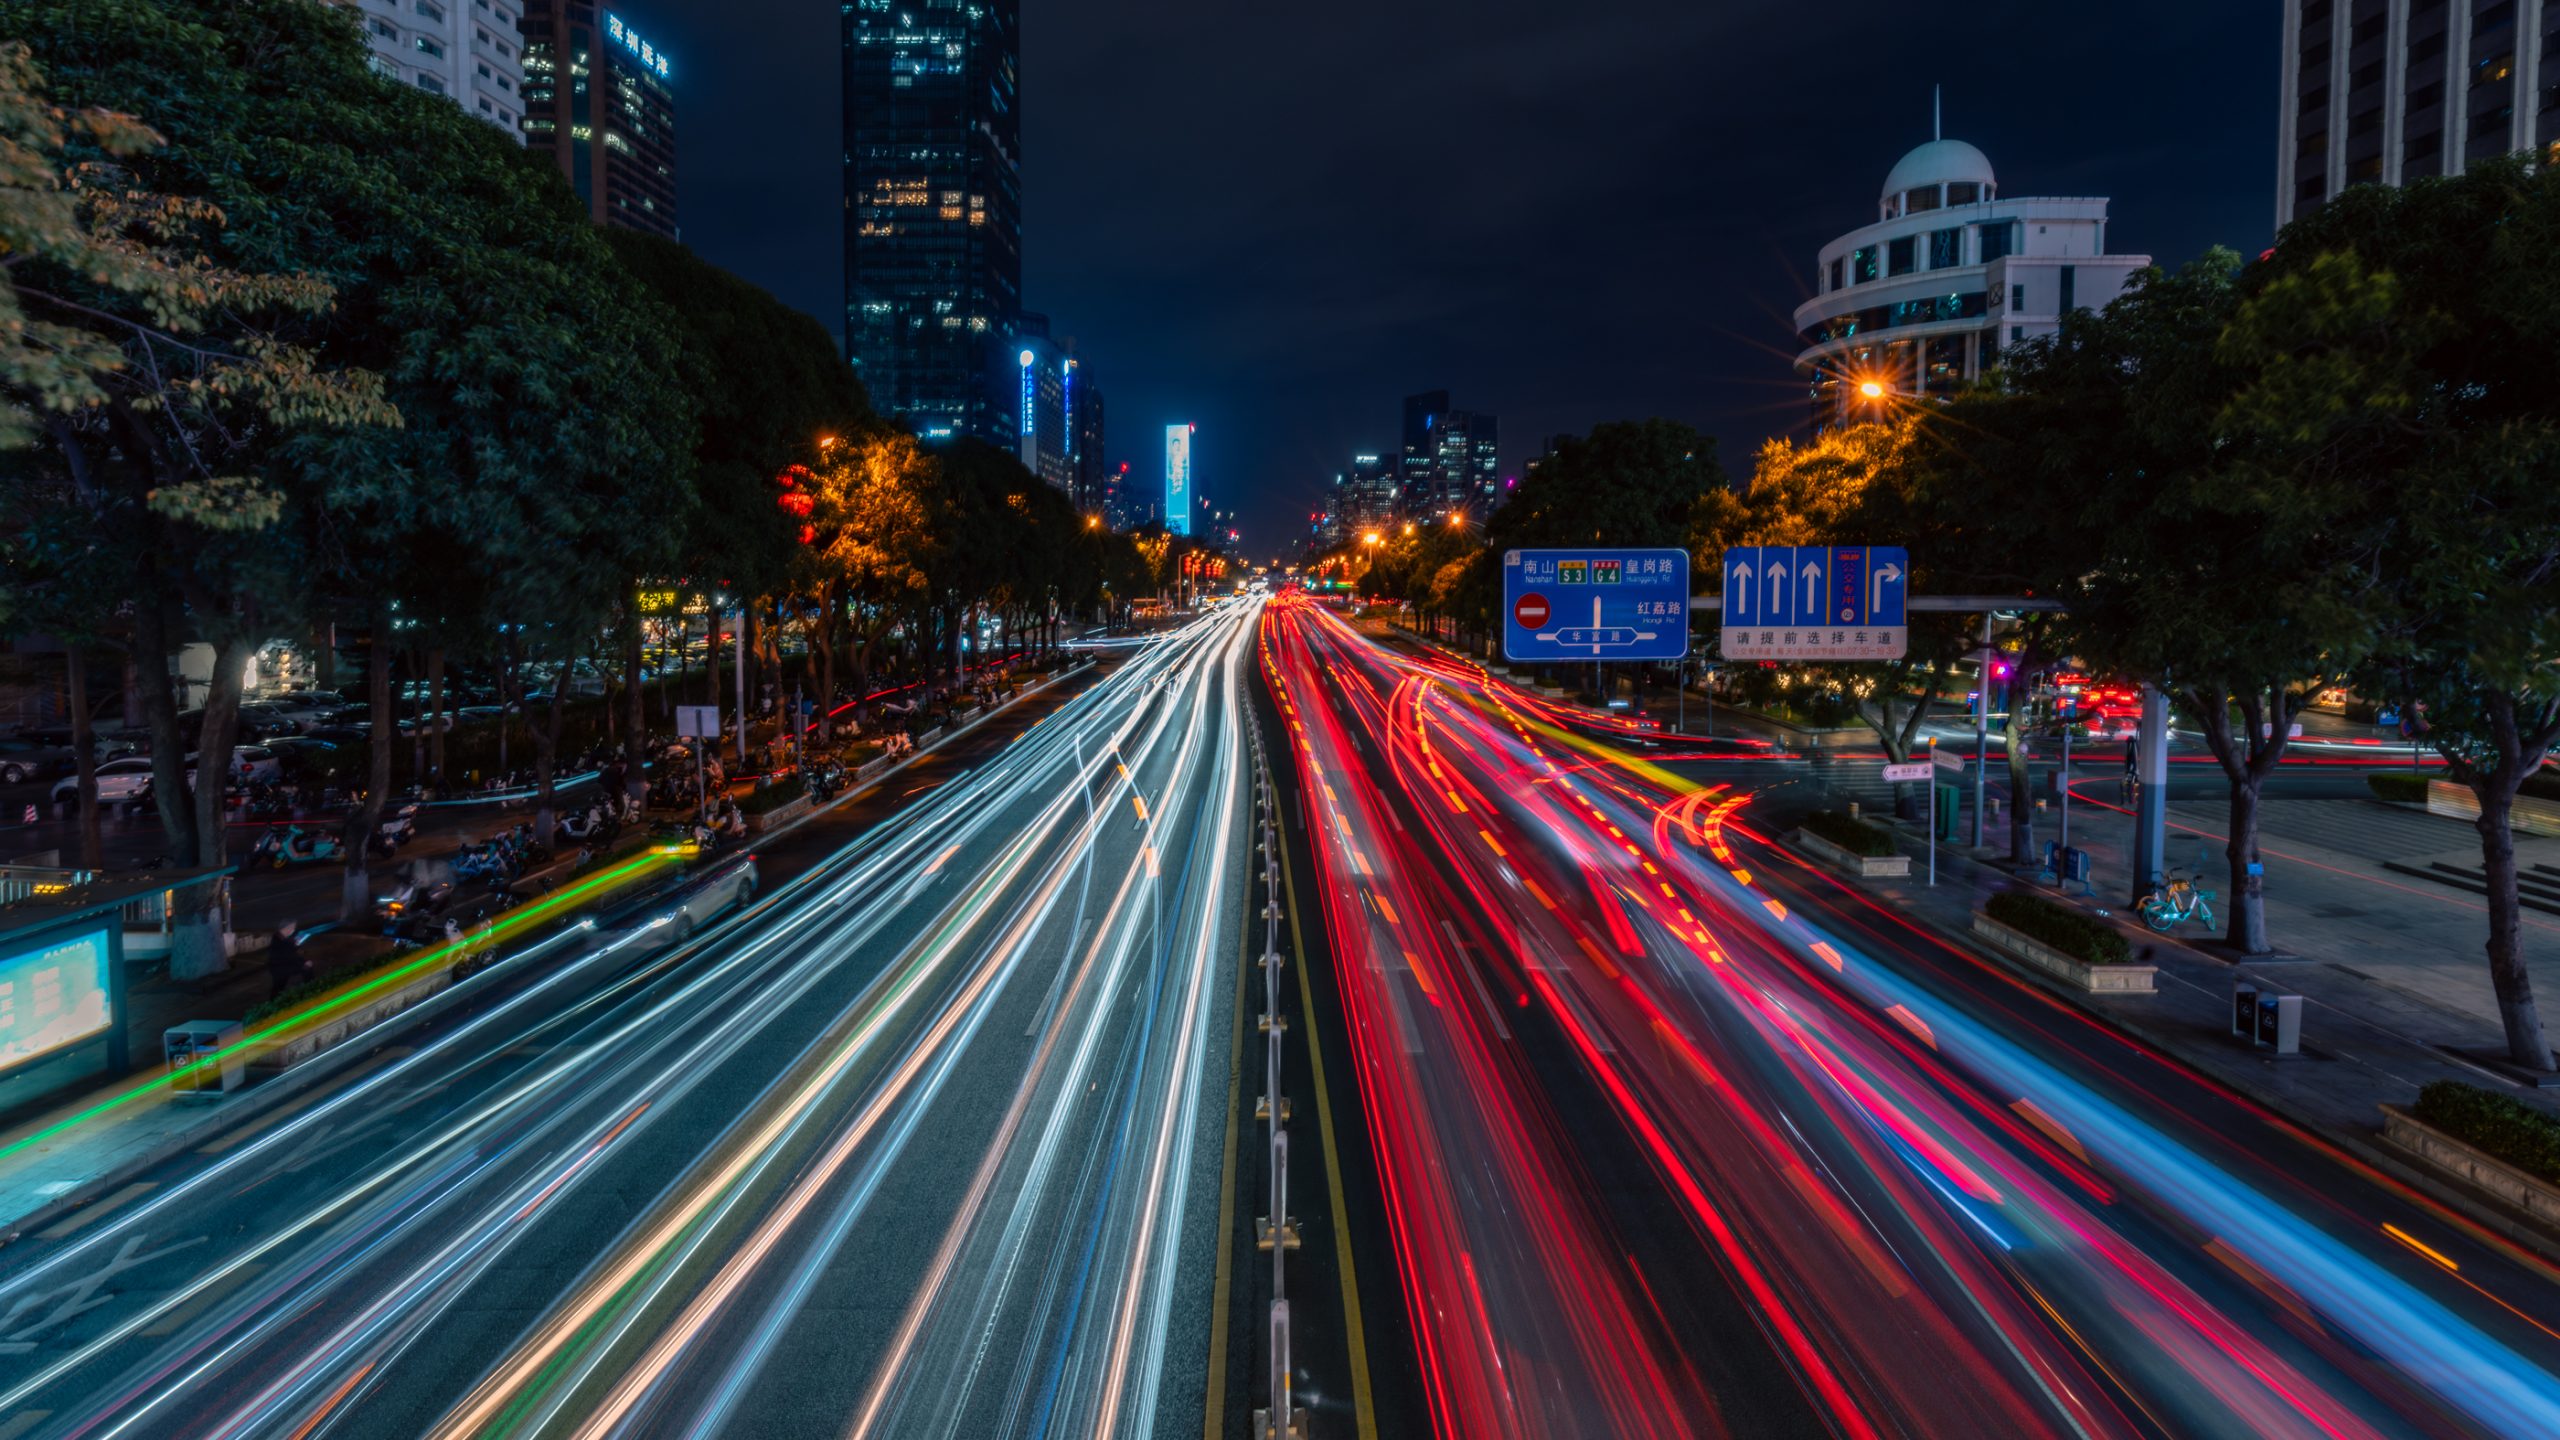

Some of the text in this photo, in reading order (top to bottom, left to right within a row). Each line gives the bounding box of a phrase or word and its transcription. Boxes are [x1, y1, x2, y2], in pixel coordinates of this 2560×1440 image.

[1524, 560, 1554, 574] 南山
[1625, 559, 1673, 574] 皇岗路
[1637, 601, 1680, 615] 红荔路
[1736, 631, 1892, 645] 请提前选择车道
